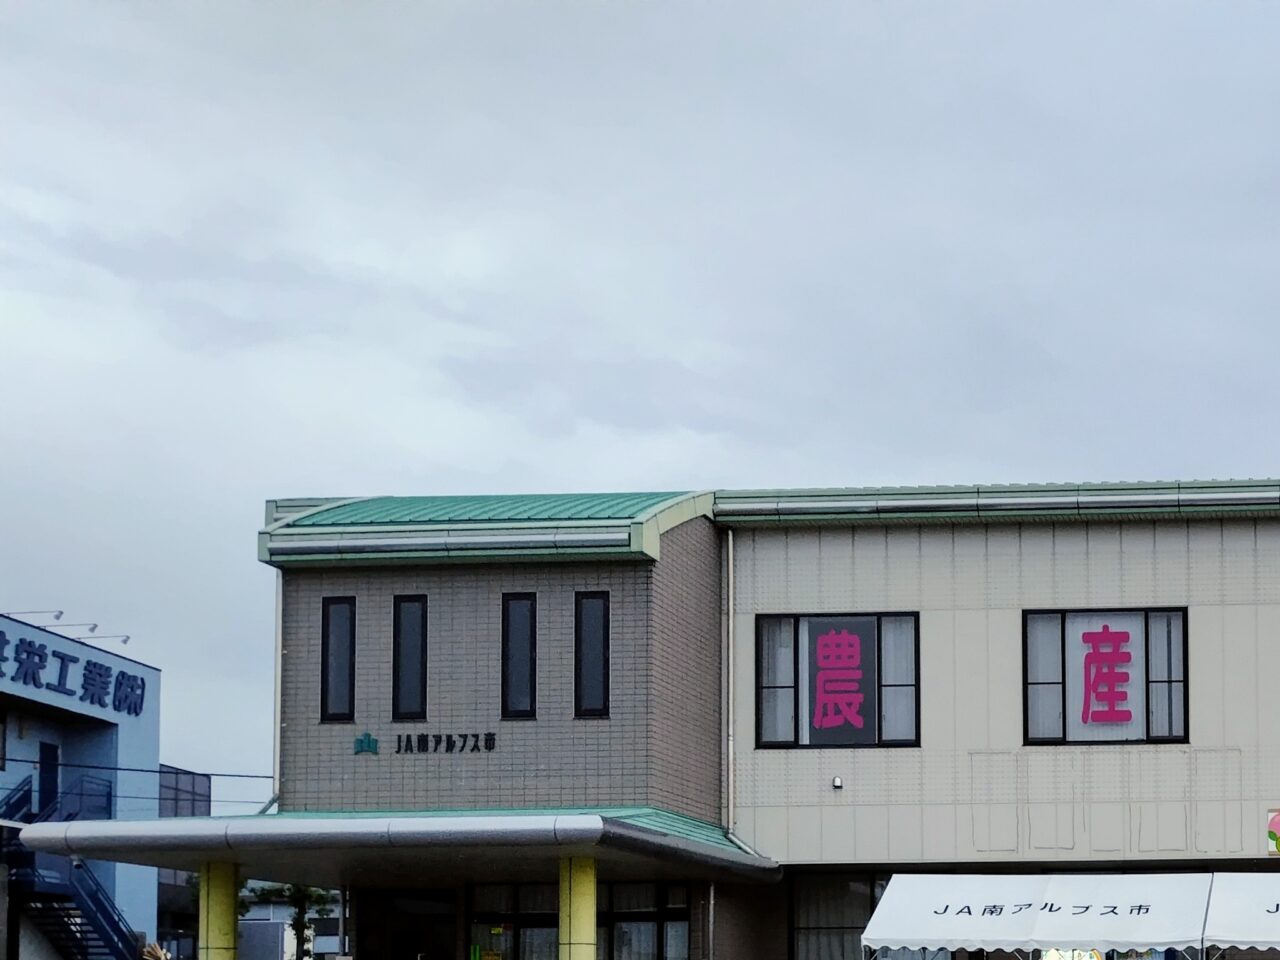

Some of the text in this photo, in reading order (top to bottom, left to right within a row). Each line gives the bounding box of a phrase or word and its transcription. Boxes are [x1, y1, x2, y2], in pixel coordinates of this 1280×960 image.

[812, 628, 866, 730] 農
[1080, 623, 1134, 725] 産
[933, 902, 1151, 917] JA南アルプス市
